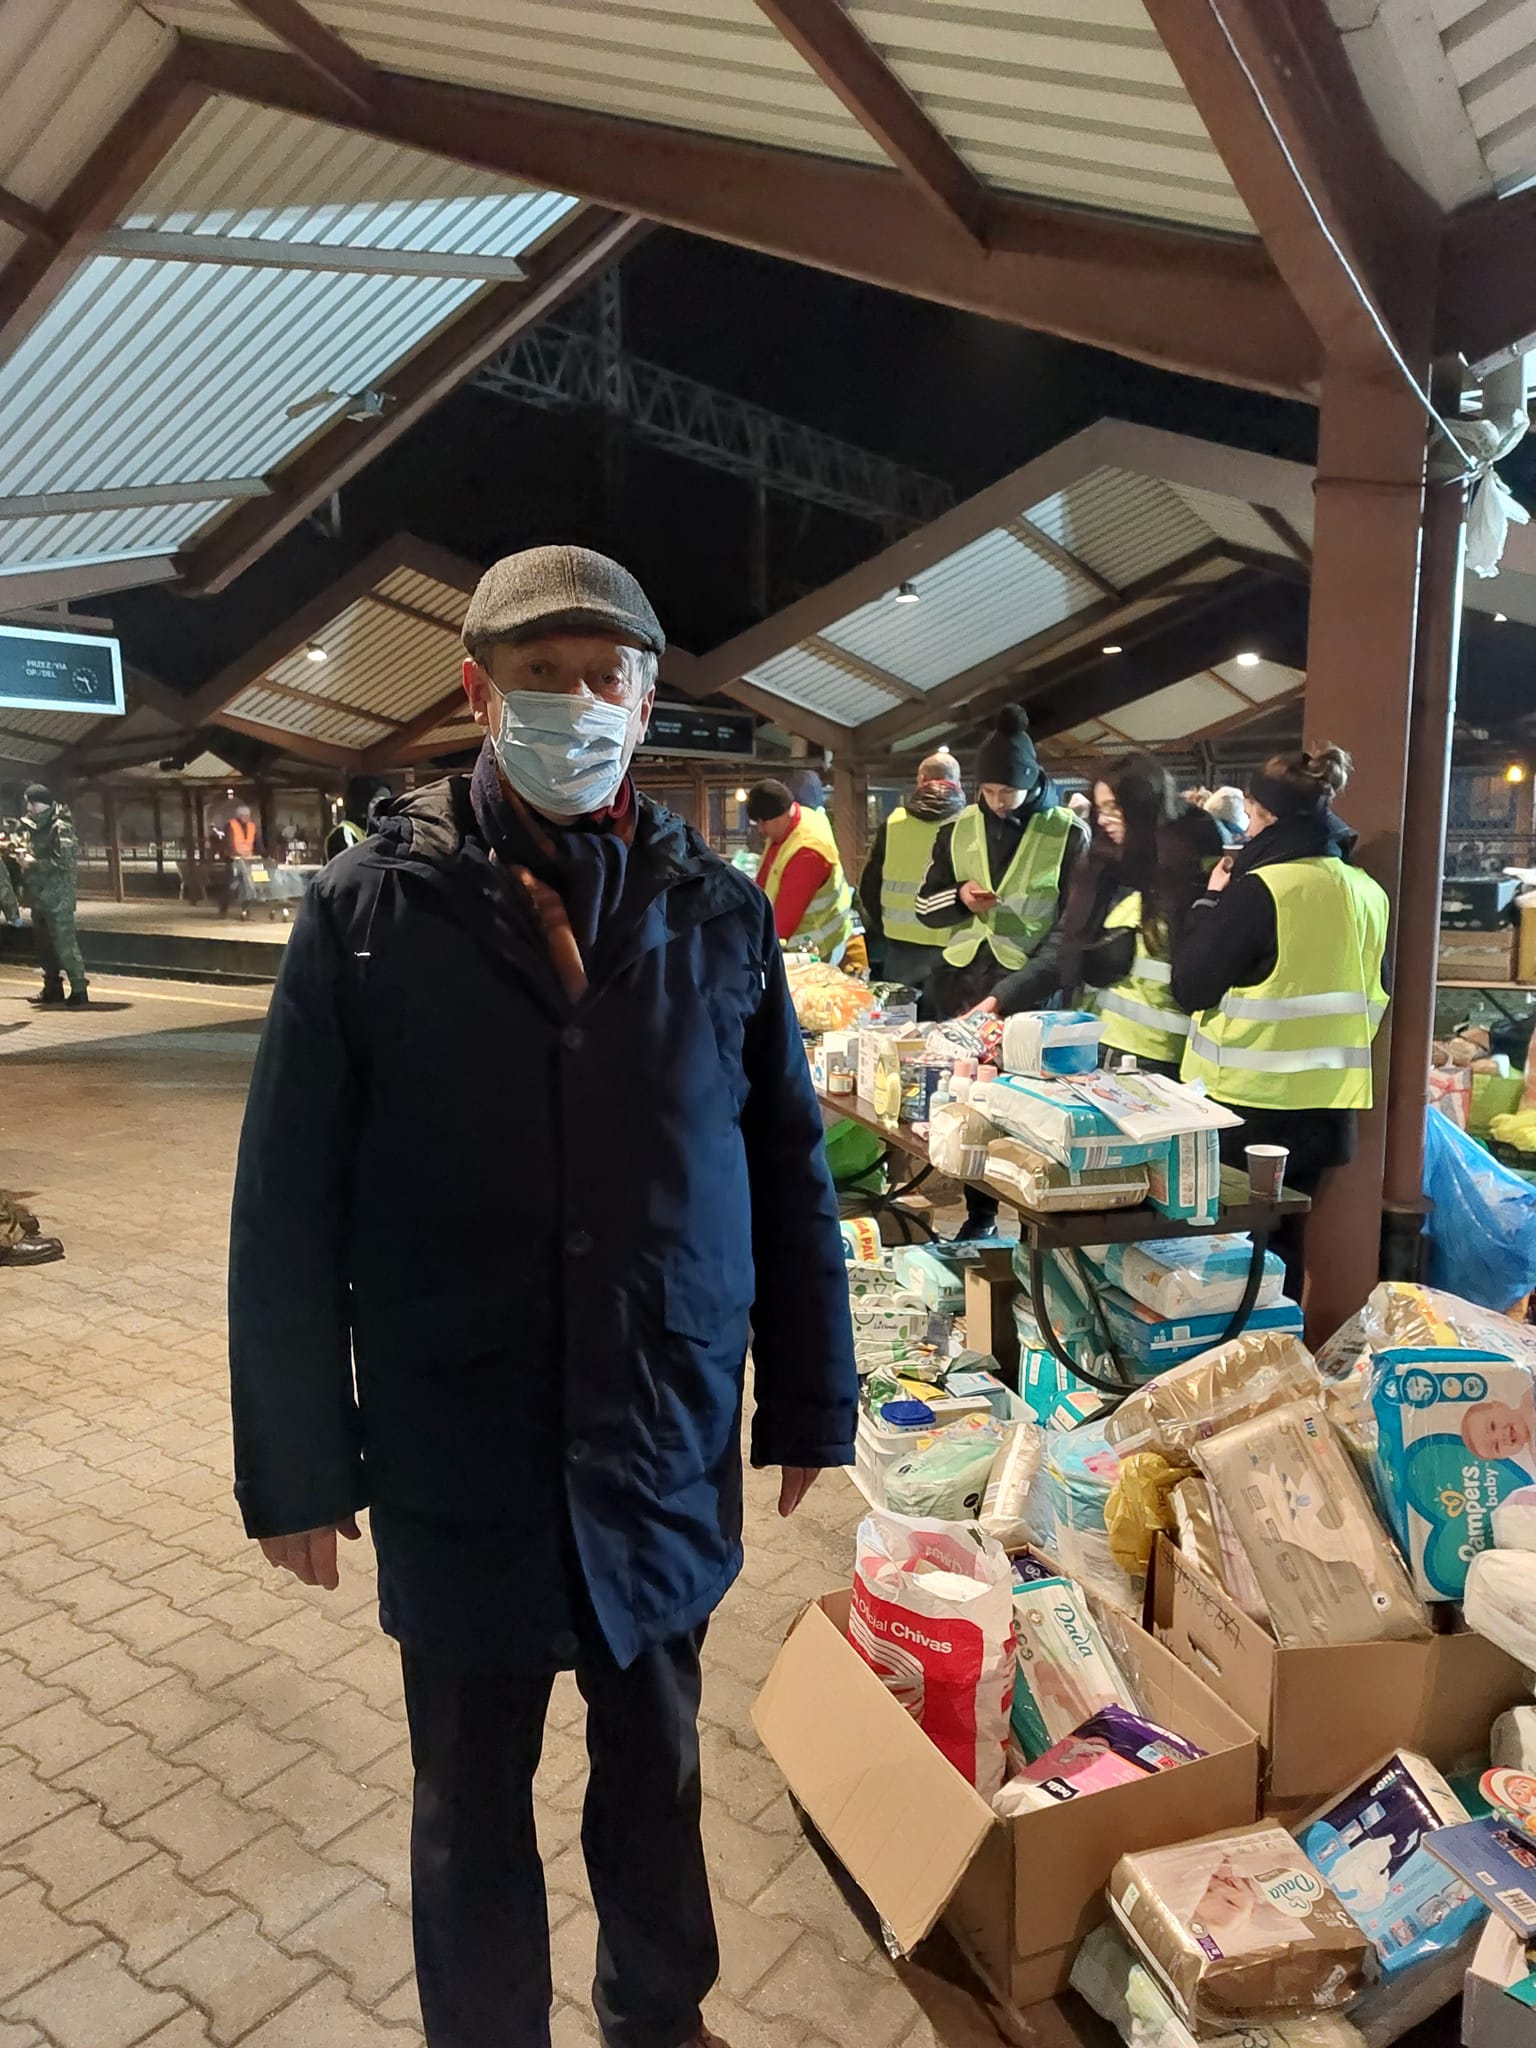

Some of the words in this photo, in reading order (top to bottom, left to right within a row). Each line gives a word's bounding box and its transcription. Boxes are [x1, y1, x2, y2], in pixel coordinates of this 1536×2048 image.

[860, 1237, 875, 1262] PAK
[1483, 1467, 1499, 1507] baby
[1457, 1465, 1487, 1562] Pampers
[890, 1621, 953, 1654] Chivas
[1053, 1602, 1094, 1658] Dada
[1267, 1873, 1315, 1900] Dada
